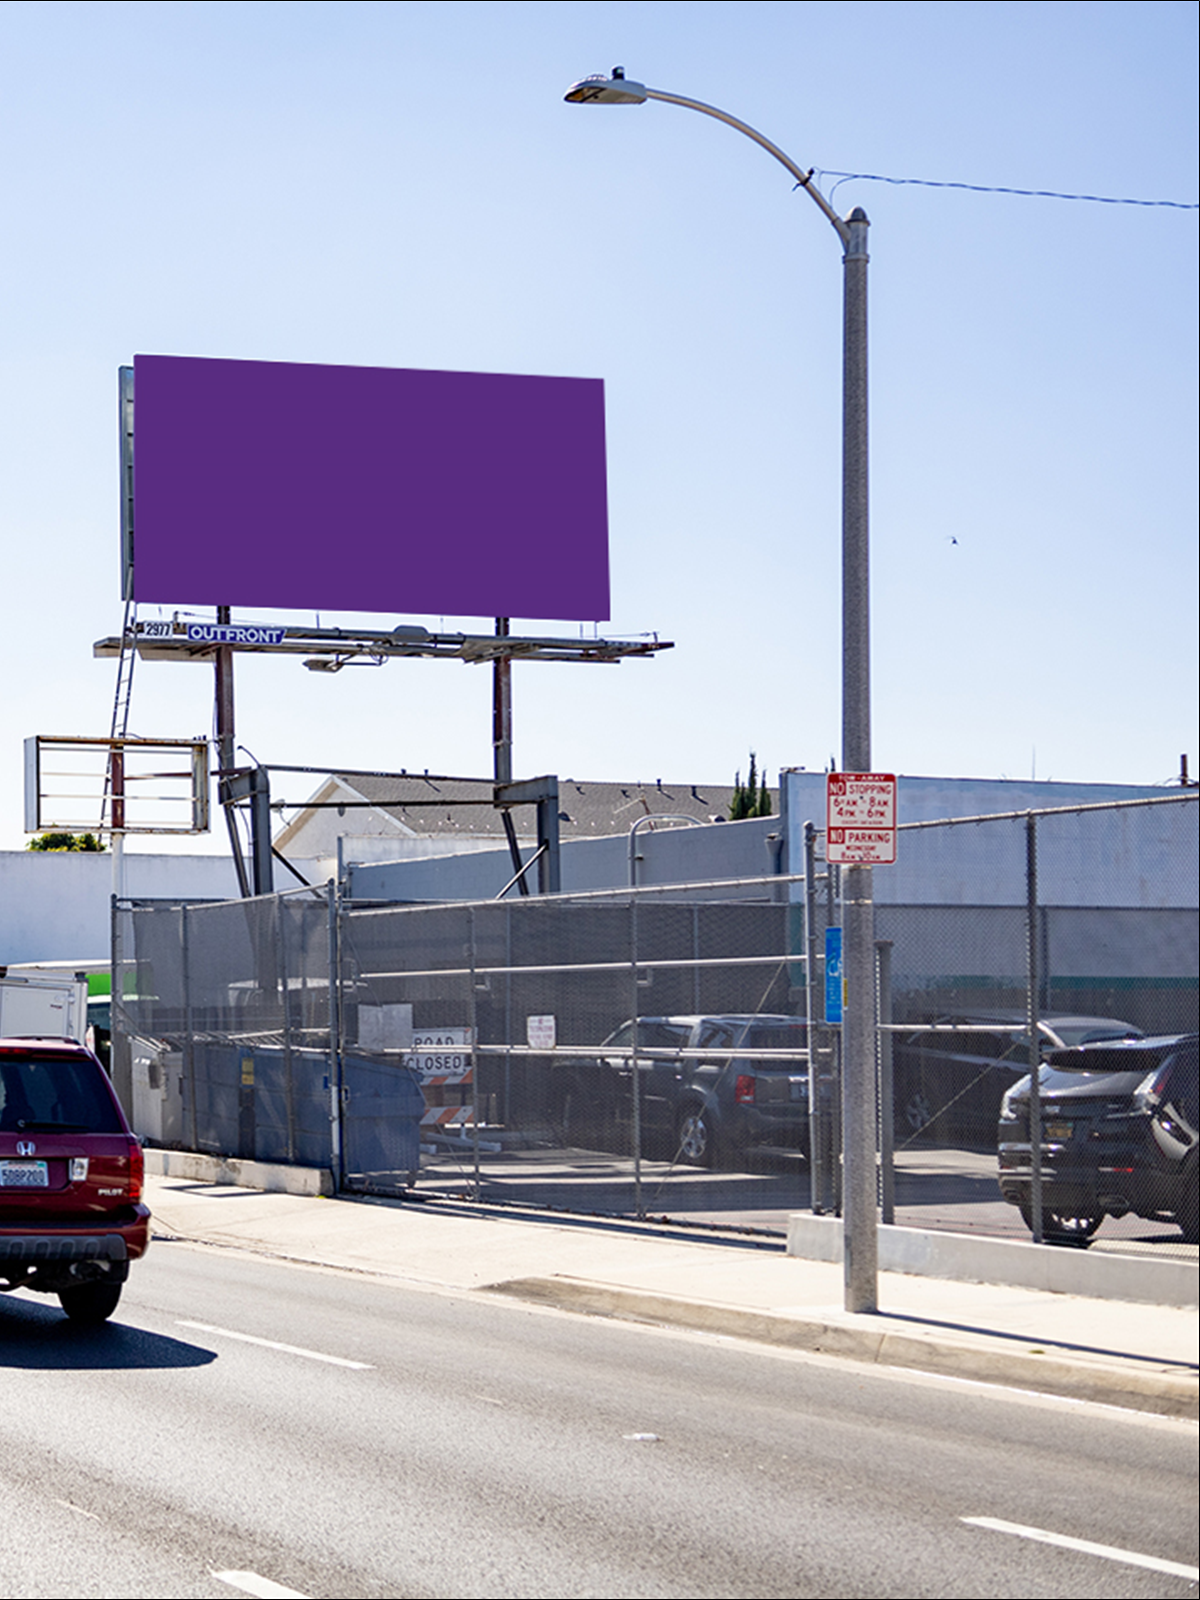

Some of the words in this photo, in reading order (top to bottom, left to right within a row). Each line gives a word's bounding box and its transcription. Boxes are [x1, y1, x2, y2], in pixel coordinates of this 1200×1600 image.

[145, 622, 171, 636] 2977
[190, 626, 281, 643] OUTFRONT
[829, 782, 845, 795] NO
[849, 784, 891, 795] STOPPING
[830, 829, 843, 843] NO
[848, 832, 891, 844] PARKING
[405, 1056, 462, 1070] CLOSED
[98, 1188, 123, 1196] PILOT
